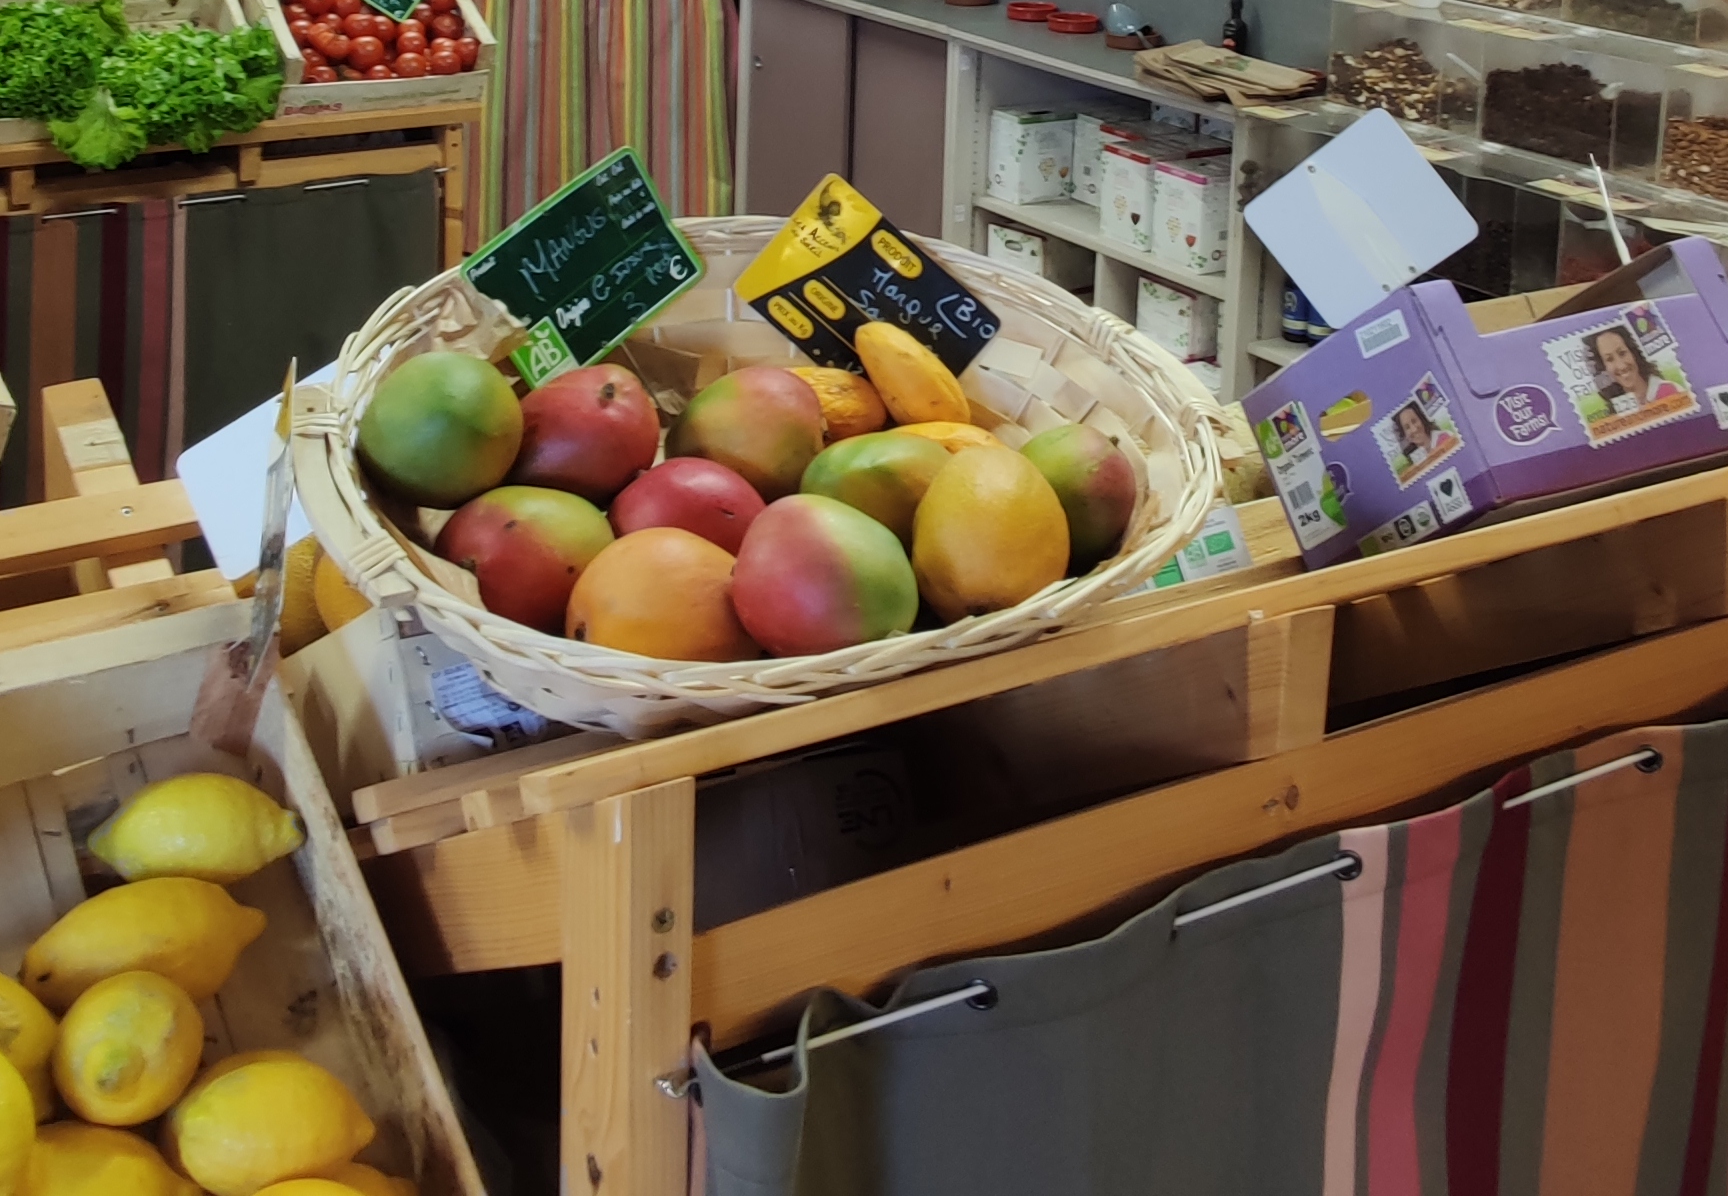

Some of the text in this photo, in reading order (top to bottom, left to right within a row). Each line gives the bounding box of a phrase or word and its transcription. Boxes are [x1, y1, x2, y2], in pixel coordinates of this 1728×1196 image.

[877, 236, 917, 273] PRODUIT
[670, 255, 688, 280] €
[872, 267, 945, 341] Mangue
[1646, 335, 1672, 355] more
[529, 337, 564, 379] AB
[1500, 392, 1531, 414] Visit
[1510, 406, 1530, 424] our
[1509, 413, 1550, 441] Farms!
[1297, 509, 1321, 528] 2kg
